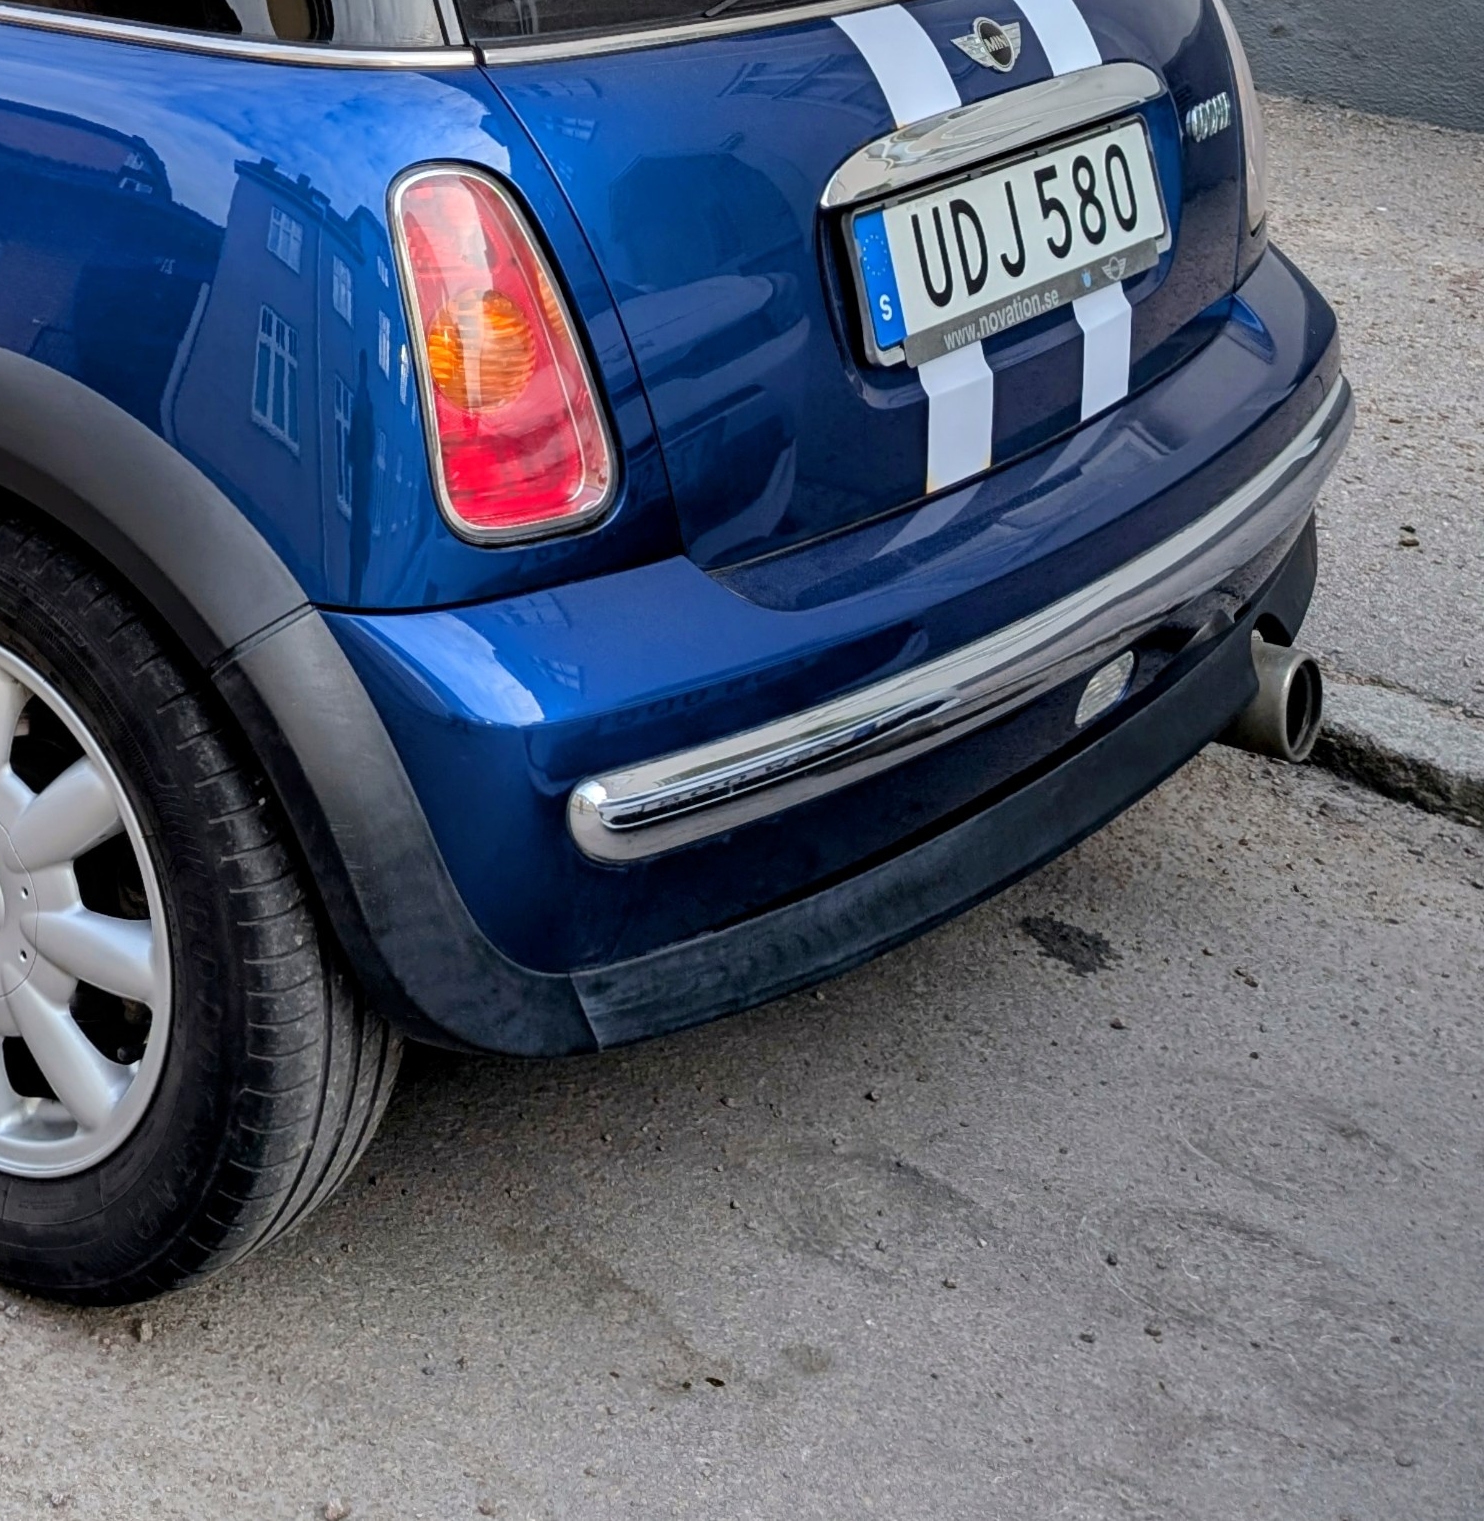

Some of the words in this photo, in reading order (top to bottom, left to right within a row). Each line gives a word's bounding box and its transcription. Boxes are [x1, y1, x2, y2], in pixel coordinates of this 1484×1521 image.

[911, 181, 1026, 308] UDJ
[1034, 143, 1138, 259] 580
[879, 294, 893, 322] S
[943, 289, 1060, 351] www.novation.se
